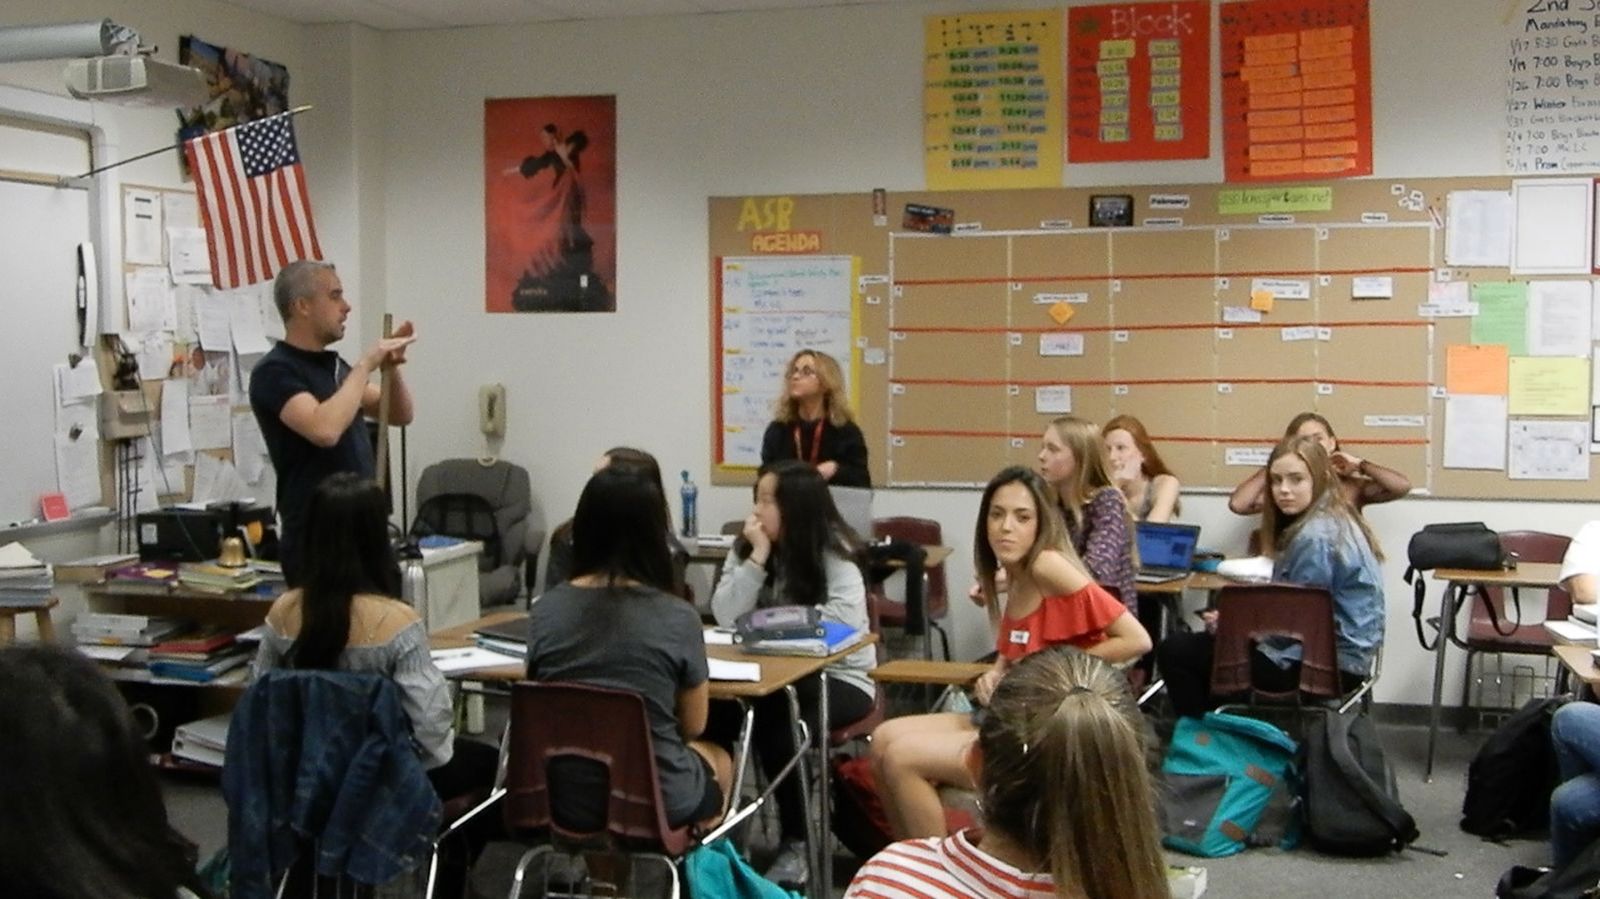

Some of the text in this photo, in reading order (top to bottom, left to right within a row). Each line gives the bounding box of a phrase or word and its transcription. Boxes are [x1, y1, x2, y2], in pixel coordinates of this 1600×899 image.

[1110, 4, 1193, 38] Block
[1533, 56, 1558, 68] 7:00
[1564, 54, 1592, 70] Boys
[1534, 75, 1560, 89] 7:00
[1151, 197, 1188, 207] February
[752, 233, 821, 252] AGENDA
